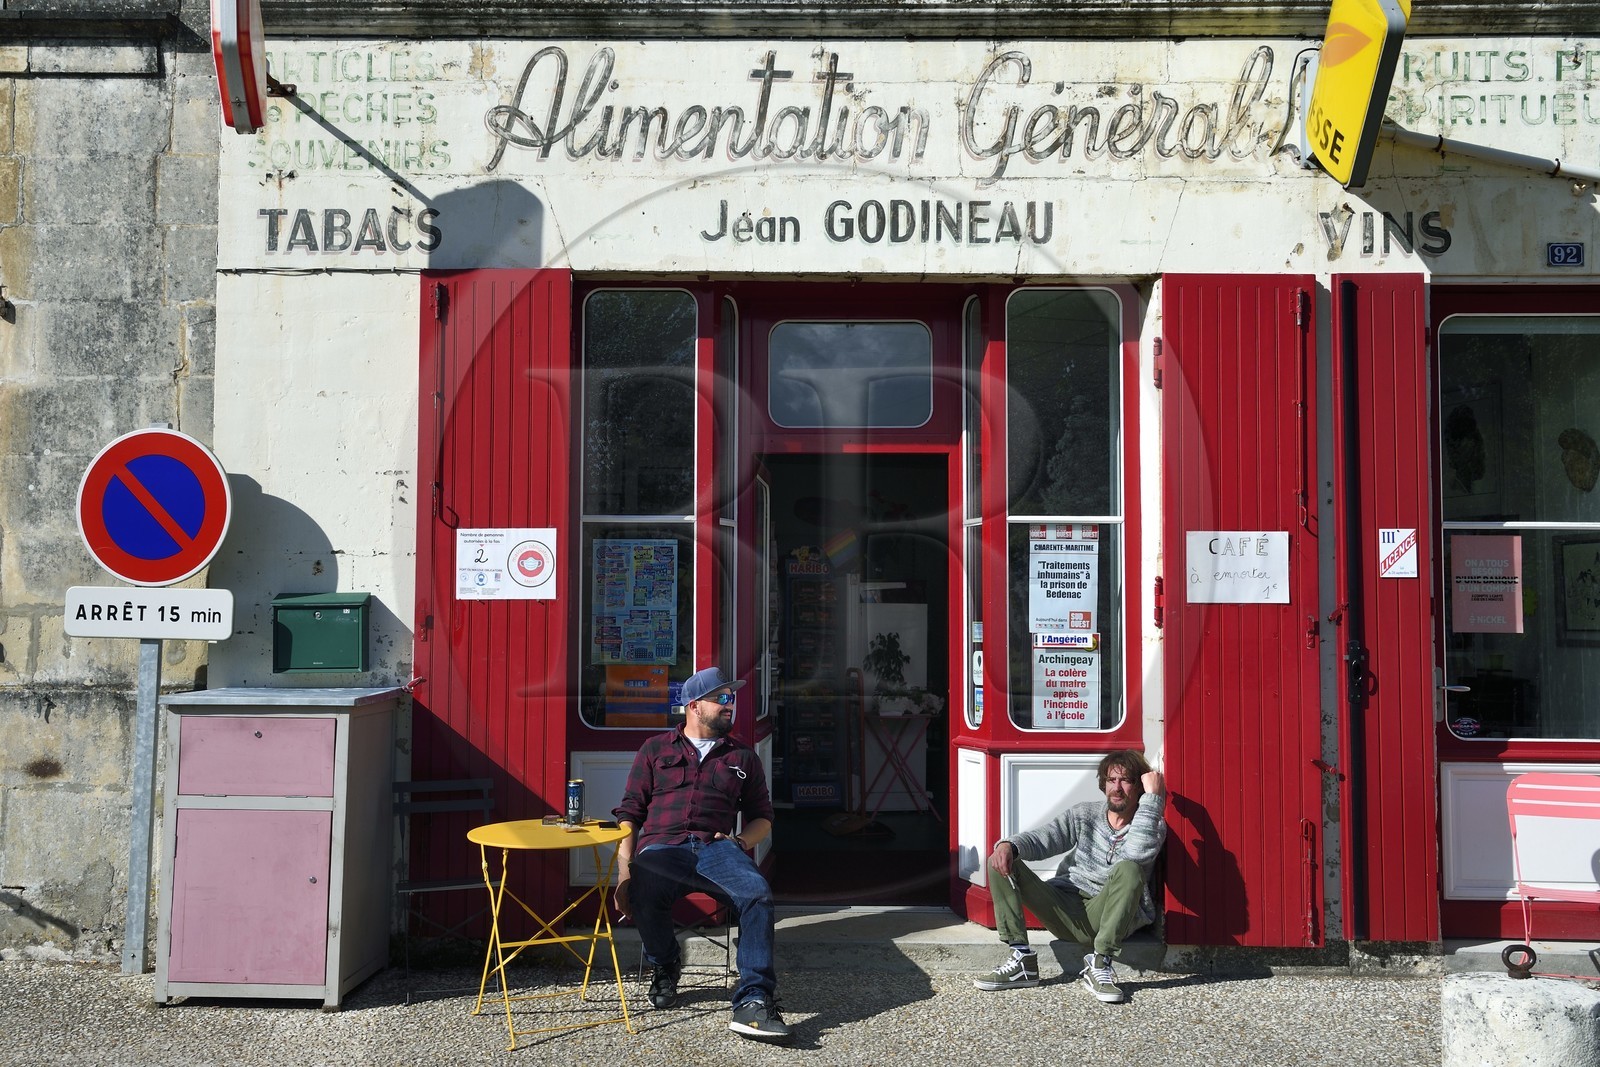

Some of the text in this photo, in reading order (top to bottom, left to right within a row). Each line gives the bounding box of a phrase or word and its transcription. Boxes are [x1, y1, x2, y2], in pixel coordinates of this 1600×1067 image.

[295, 91, 438, 124] PECHES
[485, 46, 930, 172] Alimentation
[700, 199, 1054, 245] Jean GODINEAU
[258, 207, 443, 254] TABACS
[1319, 210, 1452, 257] VINS
[1554, 246, 1579, 264] 92
[1382, 531, 1395, 543] III
[1034, 544, 1094, 552] CHARENTE-MARITIME
[1209, 533, 1269, 556] CAFÉ
[474, 548, 489, 564] 2
[1381, 532, 1416, 574] LICENCE
[1038, 561, 1090, 570] "Traitements
[1465, 559, 1479, 567] ON
[1486, 559, 1509, 567] TOUS
[789, 563, 829, 574] HARIBO
[1037, 571, 1084, 580] inhumains"
[1190, 567, 1271, 585] à emporter
[1040, 580, 1088, 590] la prison de
[1046, 590, 1082, 599] Bedenac
[75, 601, 222, 624] ARRÊT 15 min
[1070, 620, 1090, 628] OUEST
[1042, 635, 1088, 645] l'Angérien
[1038, 654, 1094, 666] Archingeay
[1045, 668, 1087, 677] La colère
[1046, 679, 1087, 688] du maire
[1053, 690, 1079, 699] après
[1043, 700, 1088, 709] l'incendie
[1047, 711, 1085, 720] à l'école
[798, 786, 834, 796] HARIBO
